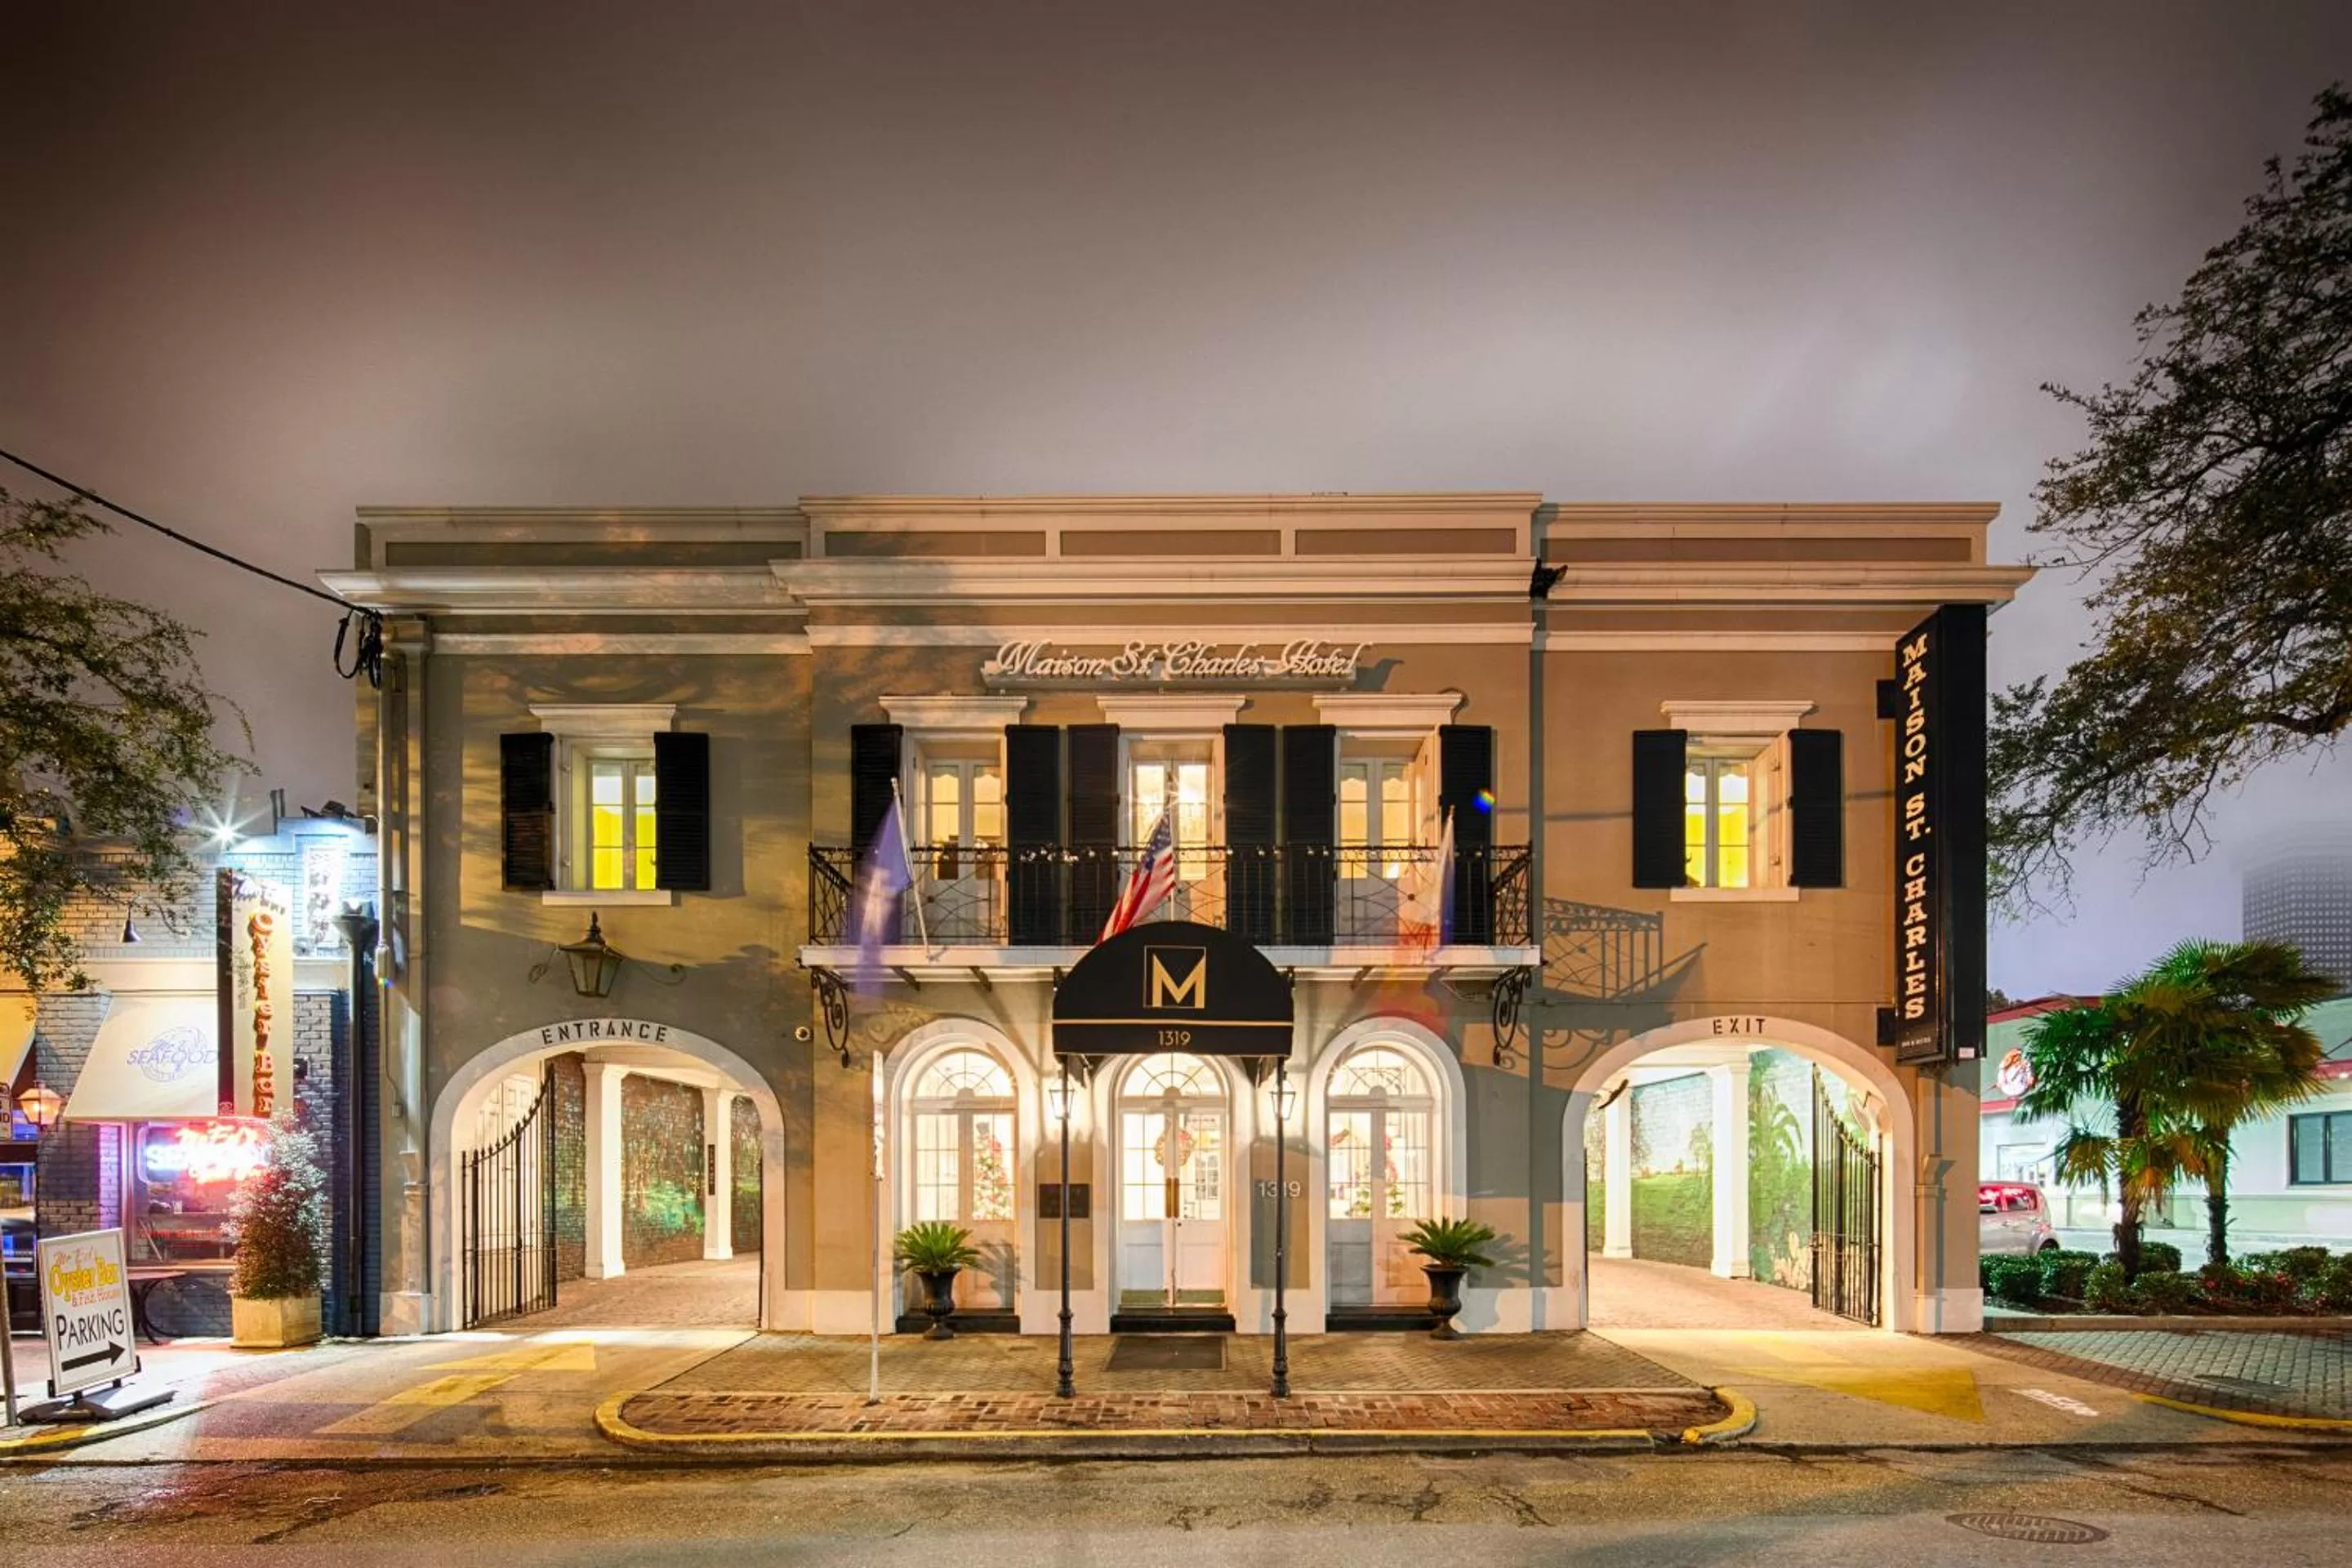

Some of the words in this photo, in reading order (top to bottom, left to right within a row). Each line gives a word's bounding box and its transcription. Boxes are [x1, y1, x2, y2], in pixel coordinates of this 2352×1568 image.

[996, 639, 1106, 675] Maison
[1161, 640, 1267, 675] Charles
[1264, 637, 1375, 675] Hotel
[1903, 633, 1928, 785] MAISON
[1905, 791, 1931, 841] ST.
[1903, 853, 1928, 1019] CHARLES
[1152, 952, 1206, 1009] M
[541, 1021, 668, 1045] ENTRANCE
[1158, 1031, 1191, 1046] 1319
[1713, 1018, 1766, 1035] EXIT
[1258, 1180, 1302, 1198] 1319
[50, 1264, 96, 1302] Oyster
[96, 1256, 119, 1286] Bar
[56, 1308, 124, 1352] PARKING
